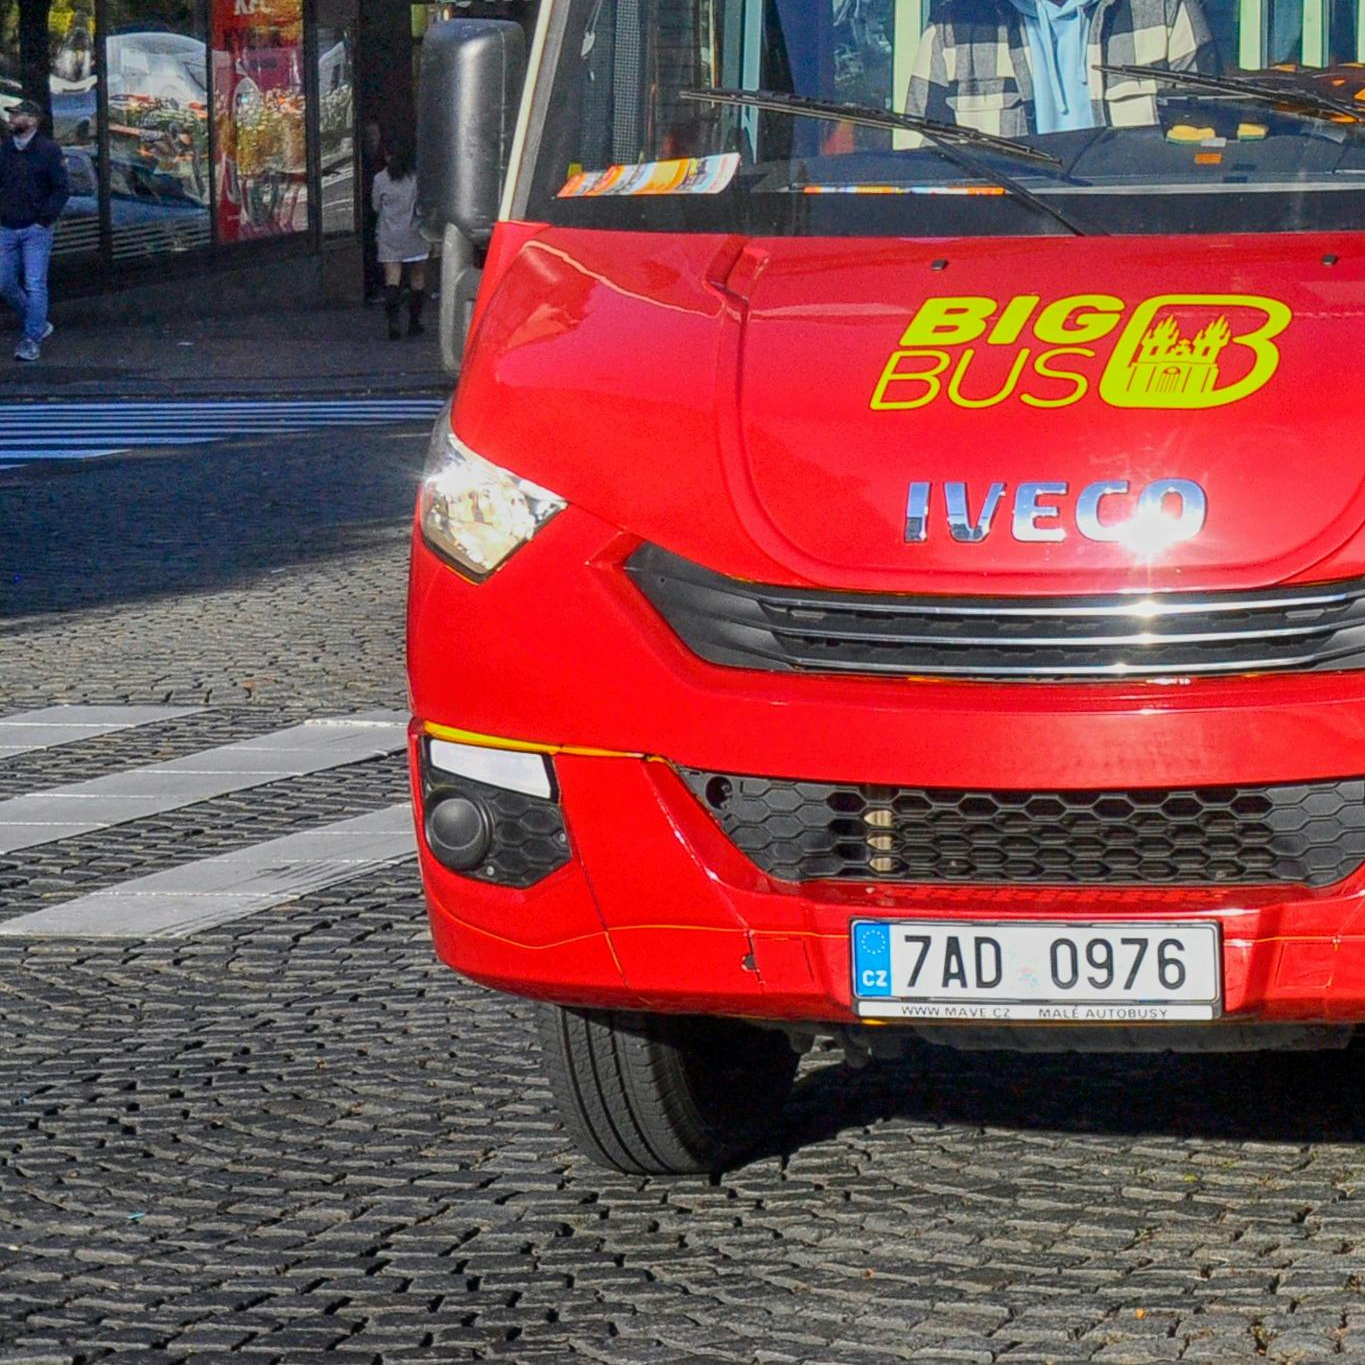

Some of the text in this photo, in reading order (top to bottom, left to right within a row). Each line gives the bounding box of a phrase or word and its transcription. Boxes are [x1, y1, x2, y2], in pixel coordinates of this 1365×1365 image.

[898, 293, 1126, 347] BIG
[869, 346, 1097, 411] BUS
[904, 477, 1208, 545] IVECO
[862, 969, 888, 988] CZ
[904, 935, 1187, 991] 7AD 0976
[1038, 1004, 1169, 1019] MALÉ AUTOBUSY
